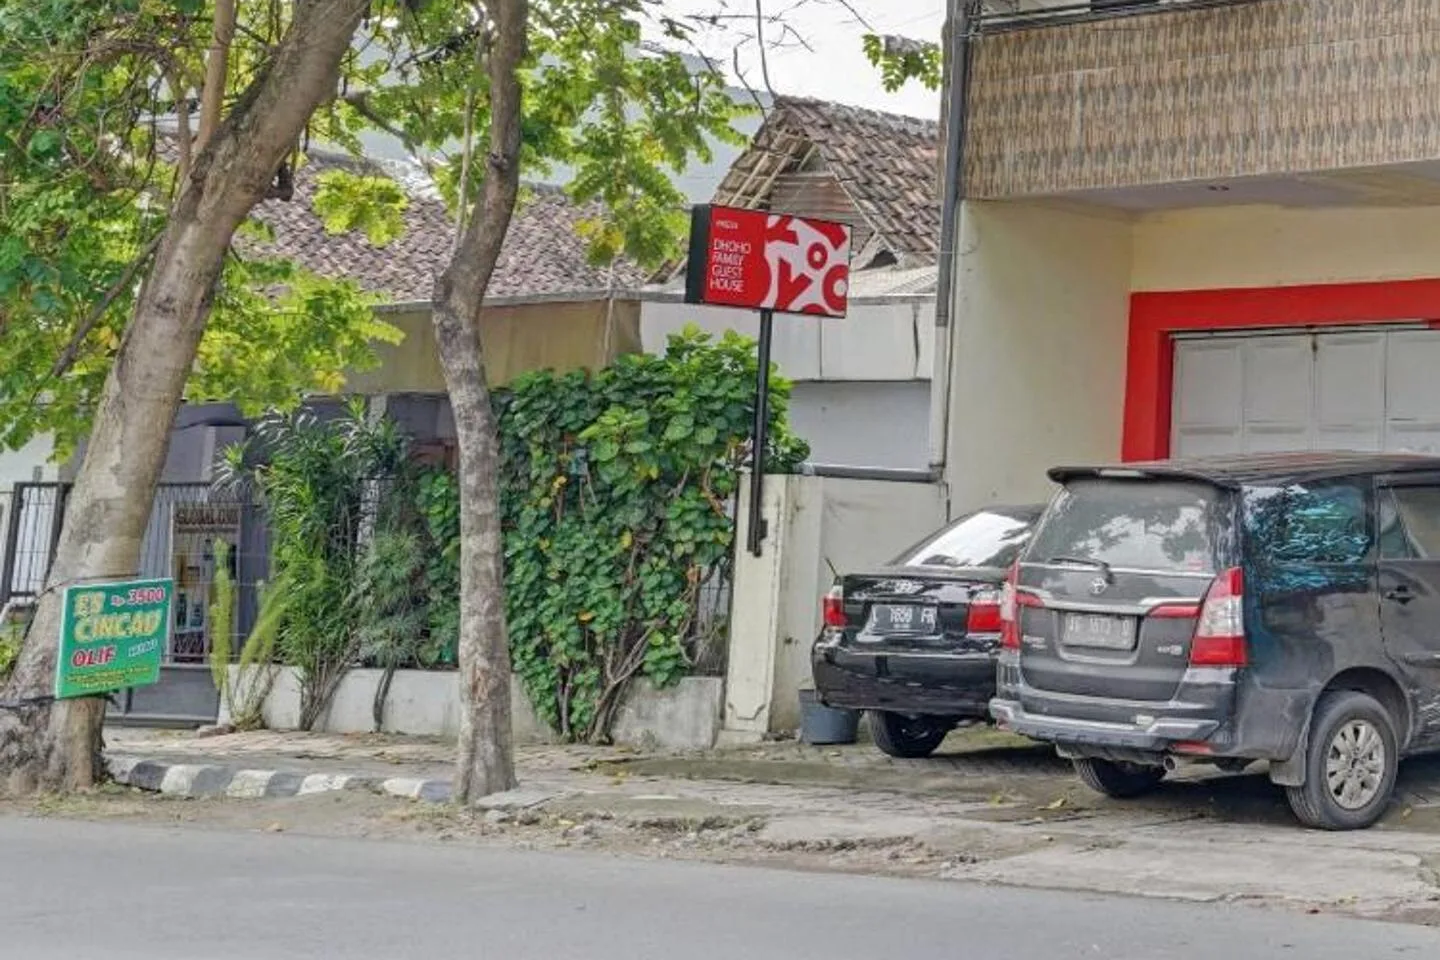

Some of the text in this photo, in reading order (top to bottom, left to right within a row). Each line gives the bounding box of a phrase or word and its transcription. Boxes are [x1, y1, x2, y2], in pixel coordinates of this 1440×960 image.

[712, 252, 744, 266] FAMILY
[711, 264, 743, 278] GUEST
[709, 278, 744, 292] HOUSE
[74, 609, 163, 643] CINCAU
[71, 645, 117, 667] OLIF
